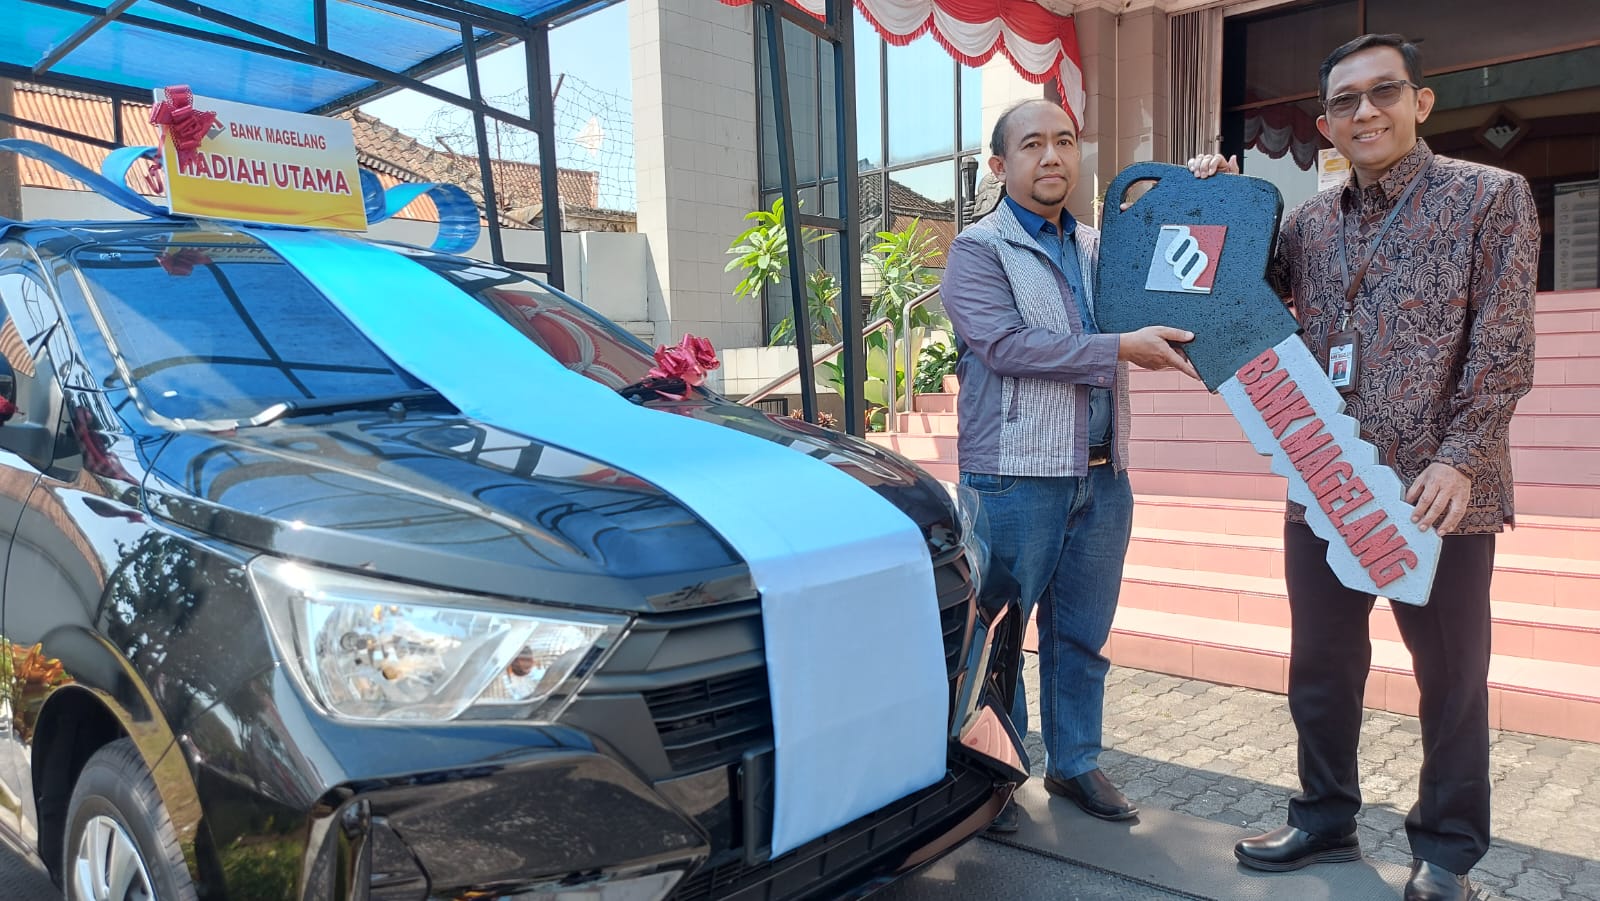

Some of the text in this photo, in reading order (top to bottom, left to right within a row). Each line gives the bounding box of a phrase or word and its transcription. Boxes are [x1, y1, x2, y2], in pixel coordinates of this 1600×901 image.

[230, 122, 327, 150] BANK MAGELANG
[273, 163, 350, 194] UTAMA
[1236, 347, 1419, 588] BANK MAGELANG
